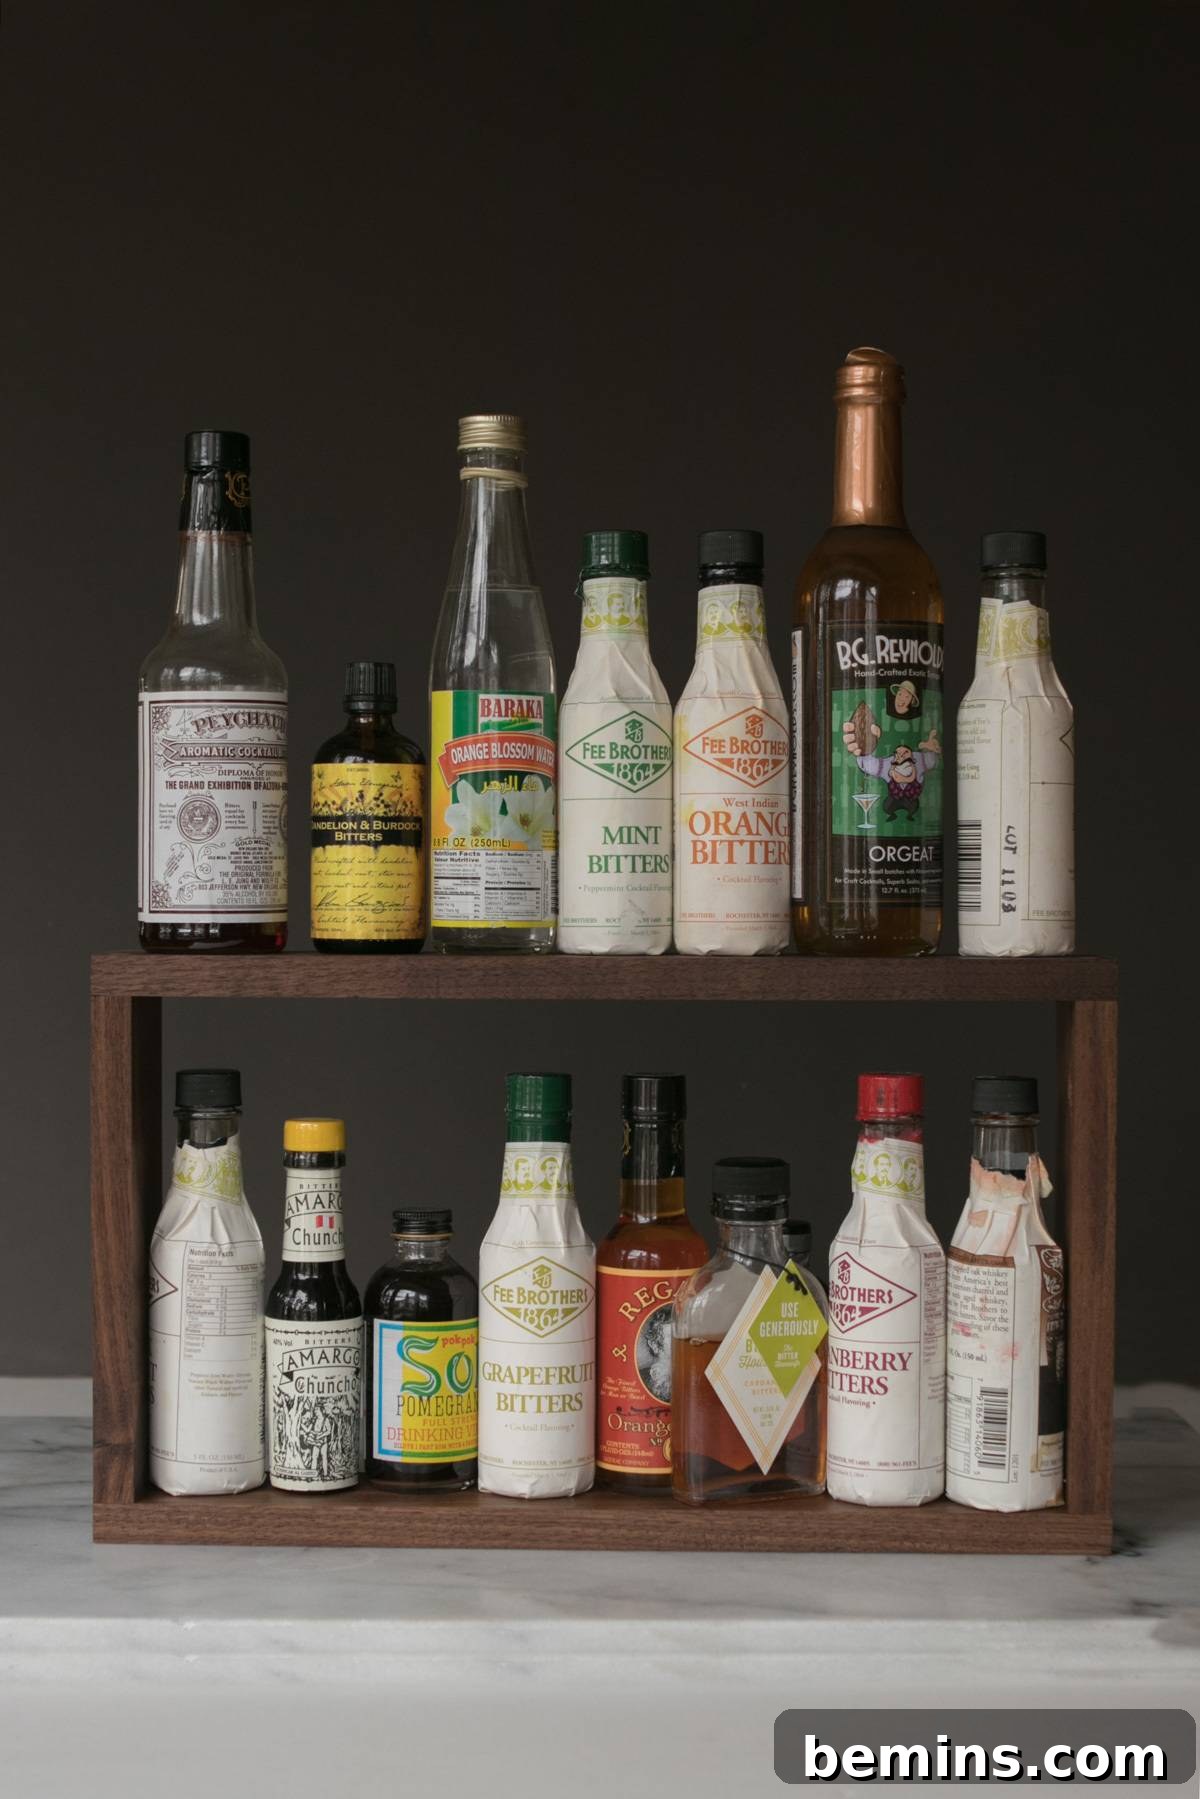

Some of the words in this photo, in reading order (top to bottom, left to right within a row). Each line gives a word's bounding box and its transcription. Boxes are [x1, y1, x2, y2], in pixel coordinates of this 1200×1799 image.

[836, 637, 876, 670] B.G.
[855, 668, 907, 678] Hand-Crafted
[480, 698, 543, 718] BARAKA
[180, 746, 236, 758] AROMATIC
[451, 742, 489, 764] ORANGE
[491, 741, 535, 760] BLOSSOM
[582, 742, 606, 760] FEE
[702, 736, 725, 754] FEE
[218, 769, 254, 777] DIPLOMA
[613, 762, 654, 782] 1864
[733, 758, 772, 779] 1864
[166, 781, 177, 790] THE
[179, 781, 204, 790] GRAND
[208, 781, 251, 790] EXHIBITION
[481, 775, 518, 794] الزهر
[723, 798, 748, 808] West
[752, 798, 779, 808] Indian
[360, 821, 370, 830] &
[688, 810, 790, 837] ORANG
[335, 831, 383, 841] BITTERS
[453, 838, 465, 847] OZ
[471, 838, 511, 848] (250mL)
[602, 825, 662, 845] MINT
[869, 845, 935, 862] ORGEAT
[587, 854, 669, 874] BITTERS
[190, 1248, 217, 1257] Nutrition
[964, 1276, 991, 1287] America's
[994, 1279, 1008, 1287] best
[982, 1269, 1008, 1278] whiskey
[493, 1285, 514, 1303] FEE
[517, 1287, 588, 1305] BROTHERS
[979, 1296, 1008, 1306] whiskey,
[996, 1288, 1008, 1296] and
[522, 1307, 562, 1328] 1864
[781, 1302, 799, 1318] USE
[998, 1315, 1008, 1323] the
[760, 1320, 819, 1338] GENEROUSLY
[287, 1348, 360, 1371] AMARGO
[612, 1344, 626, 1362] &
[829, 1346, 913, 1372] NBERRY
[482, 1361, 594, 1385] GRAPEFRUIT
[294, 1376, 357, 1395] Chuncho
[496, 1392, 583, 1414] BITTERS
[842, 1397, 871, 1409] Flavoring
[387, 1425, 463, 1442] DRINKING
